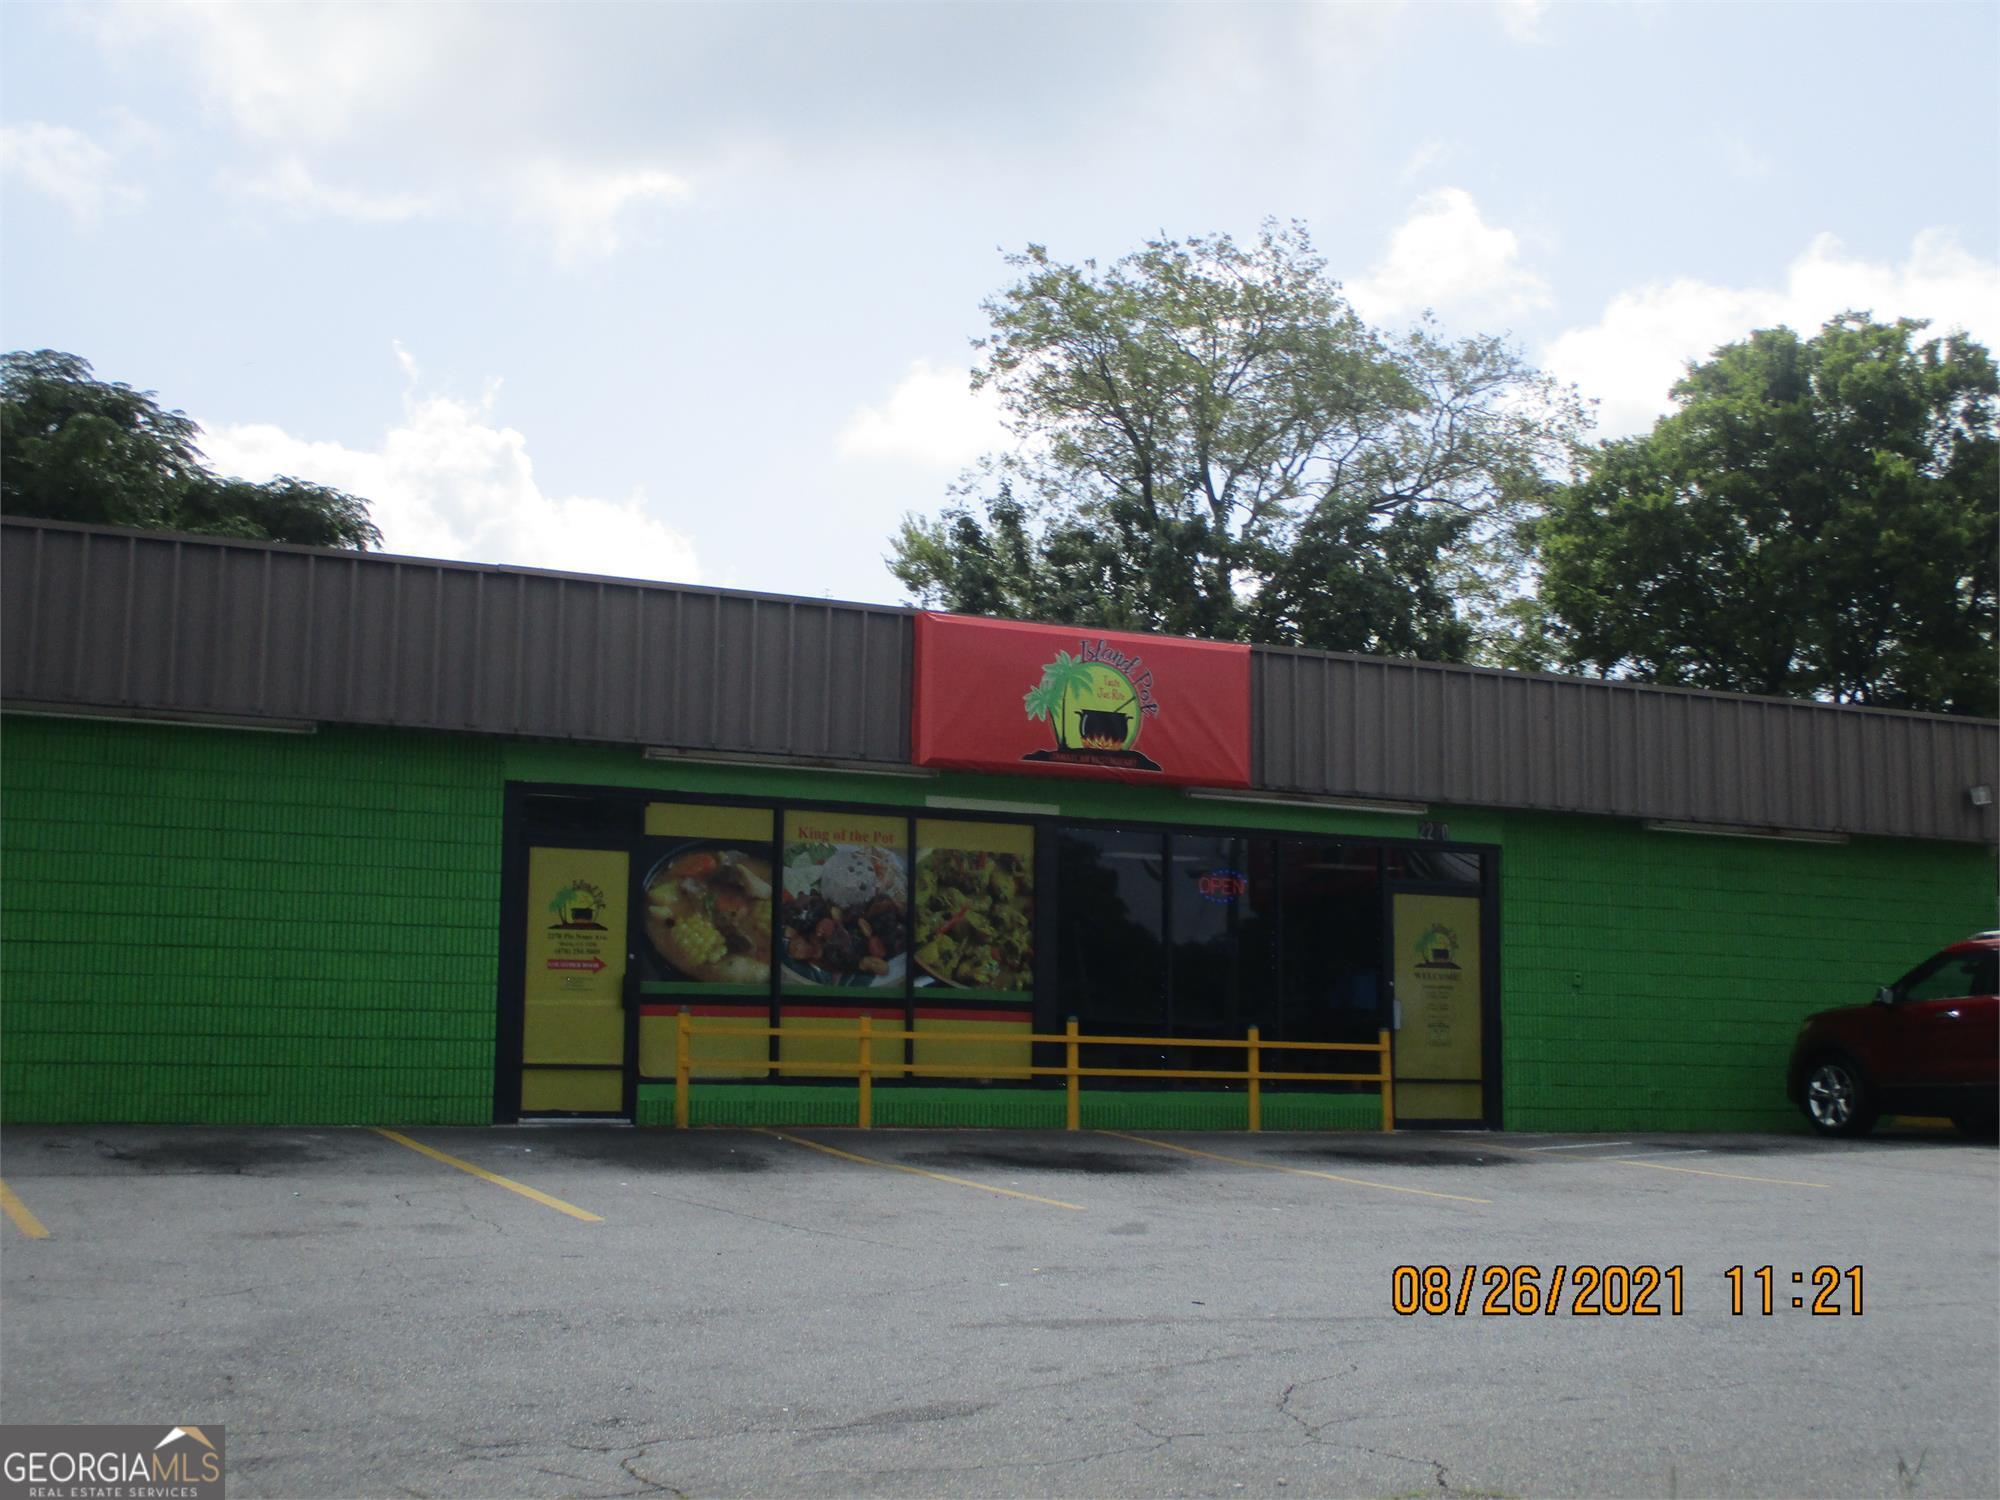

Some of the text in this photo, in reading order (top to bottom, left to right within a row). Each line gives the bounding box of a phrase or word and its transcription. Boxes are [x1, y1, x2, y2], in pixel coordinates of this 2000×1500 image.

[1080, 639, 1160, 717] Island Pot
[798, 826, 895, 844] King of the Pot
[1419, 822, 1449, 842] 220
[1198, 876, 1246, 896] OPEN
